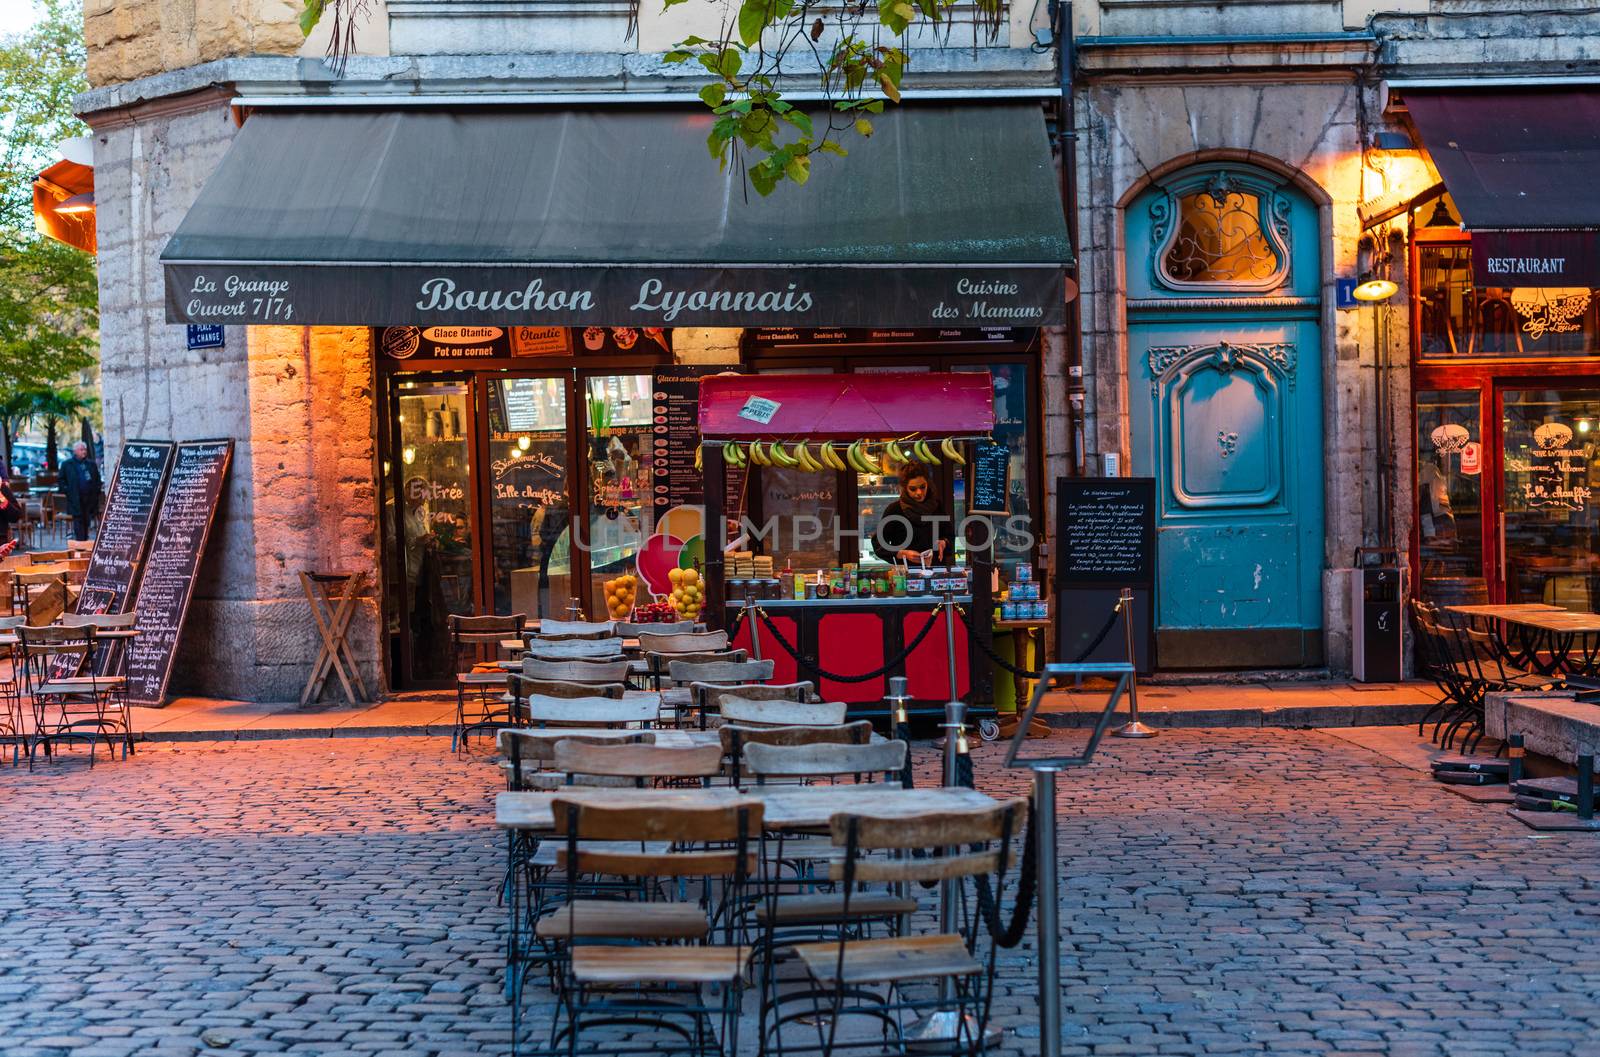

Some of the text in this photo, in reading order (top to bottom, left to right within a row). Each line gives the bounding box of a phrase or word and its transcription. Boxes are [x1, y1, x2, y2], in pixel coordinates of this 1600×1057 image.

[1487, 258, 1566, 273] RESTAURANT
[191, 275, 290, 297] La Grange
[957, 278, 1018, 295] Cuisine
[186, 298, 247, 316] Ouvert
[415, 276, 813, 322] Bouchon Lyonnais
[932, 301, 1044, 318] des Mamans
[197, 332, 220, 343] CHANGE
[434, 327, 493, 338] Glace Otantic
[434, 346, 493, 357] Pot ou cornet
[410, 480, 465, 501] Entrée
[494, 483, 520, 499] Salle
[1522, 483, 1593, 505] Salle chauffée
[415, 504, 456, 524] Open
